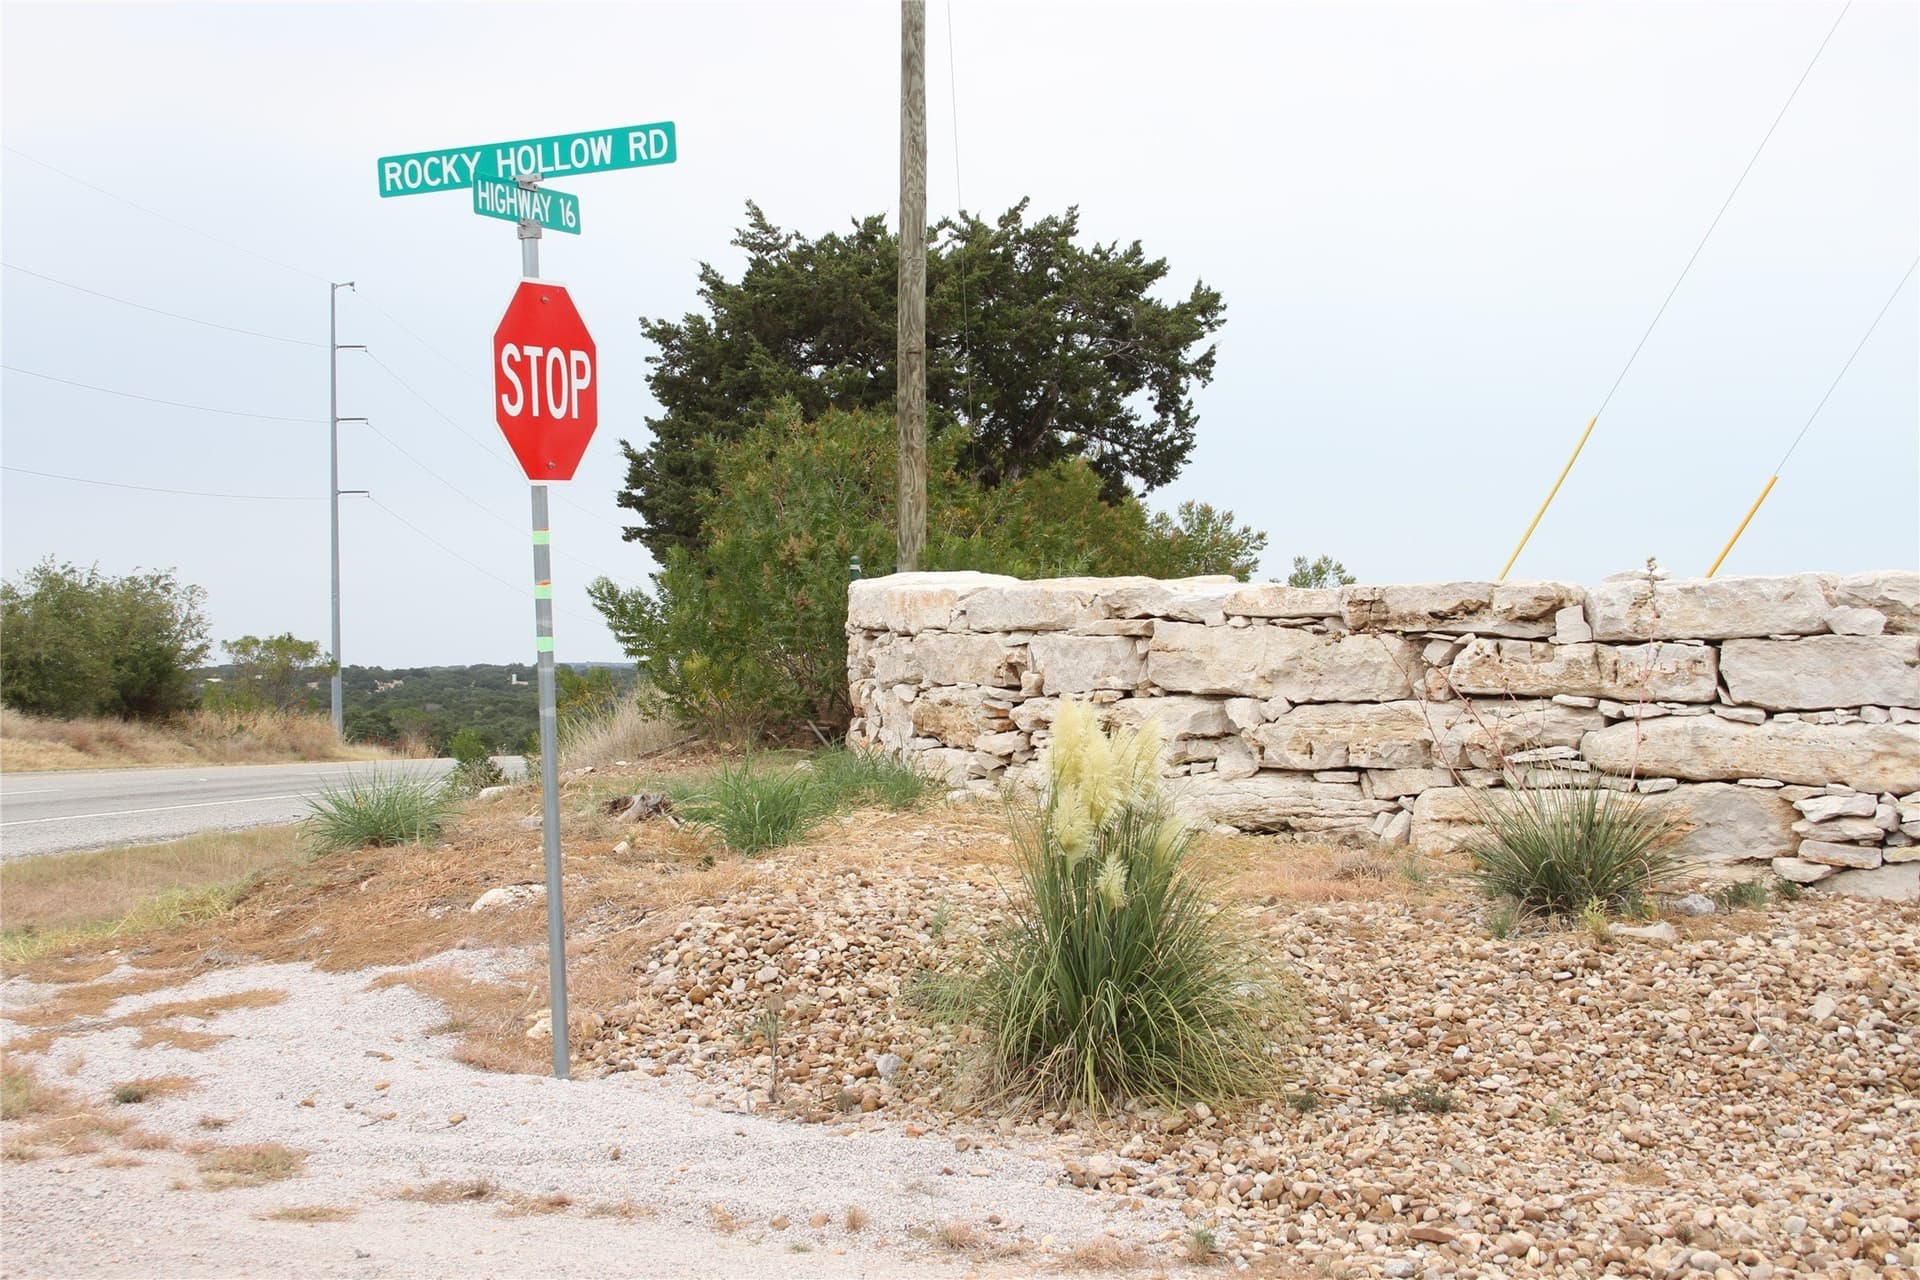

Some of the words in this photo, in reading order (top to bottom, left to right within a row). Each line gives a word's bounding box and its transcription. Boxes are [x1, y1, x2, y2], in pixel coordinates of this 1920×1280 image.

[384, 151, 481, 191] ROCKY
[496, 134, 613, 178] HOLLOW
[628, 128, 669, 162] RD
[478, 179, 552, 223] HIGHWAY
[560, 197, 577, 228] 16
[501, 342, 592, 420] STOP
